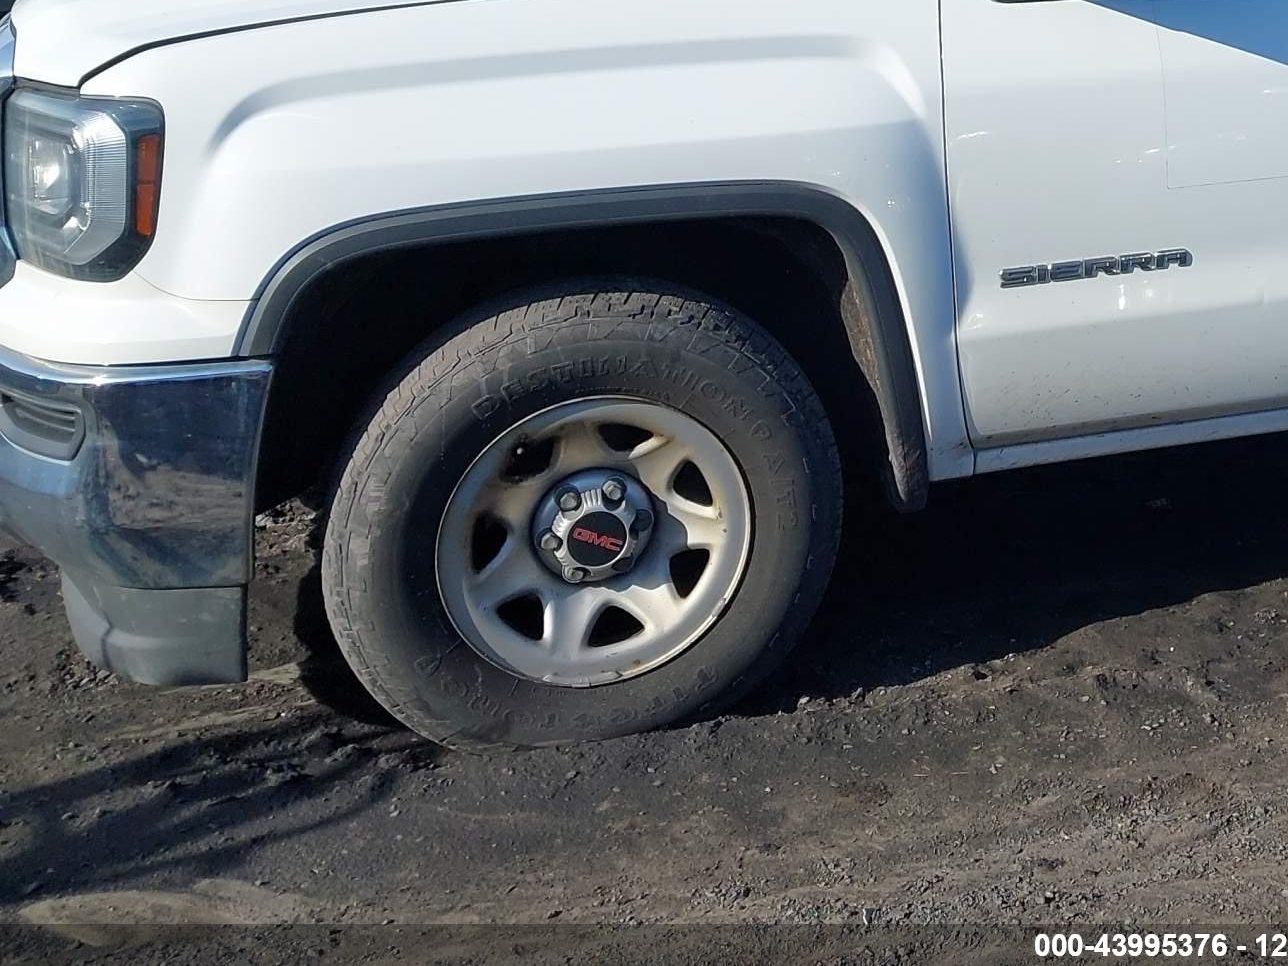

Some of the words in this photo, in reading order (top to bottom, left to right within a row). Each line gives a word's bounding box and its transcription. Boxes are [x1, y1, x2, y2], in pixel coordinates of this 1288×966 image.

[1000, 247, 1194, 289] SIERRA
[469, 352, 752, 422] DESTINATION
[572, 527, 624, 552] GMC
